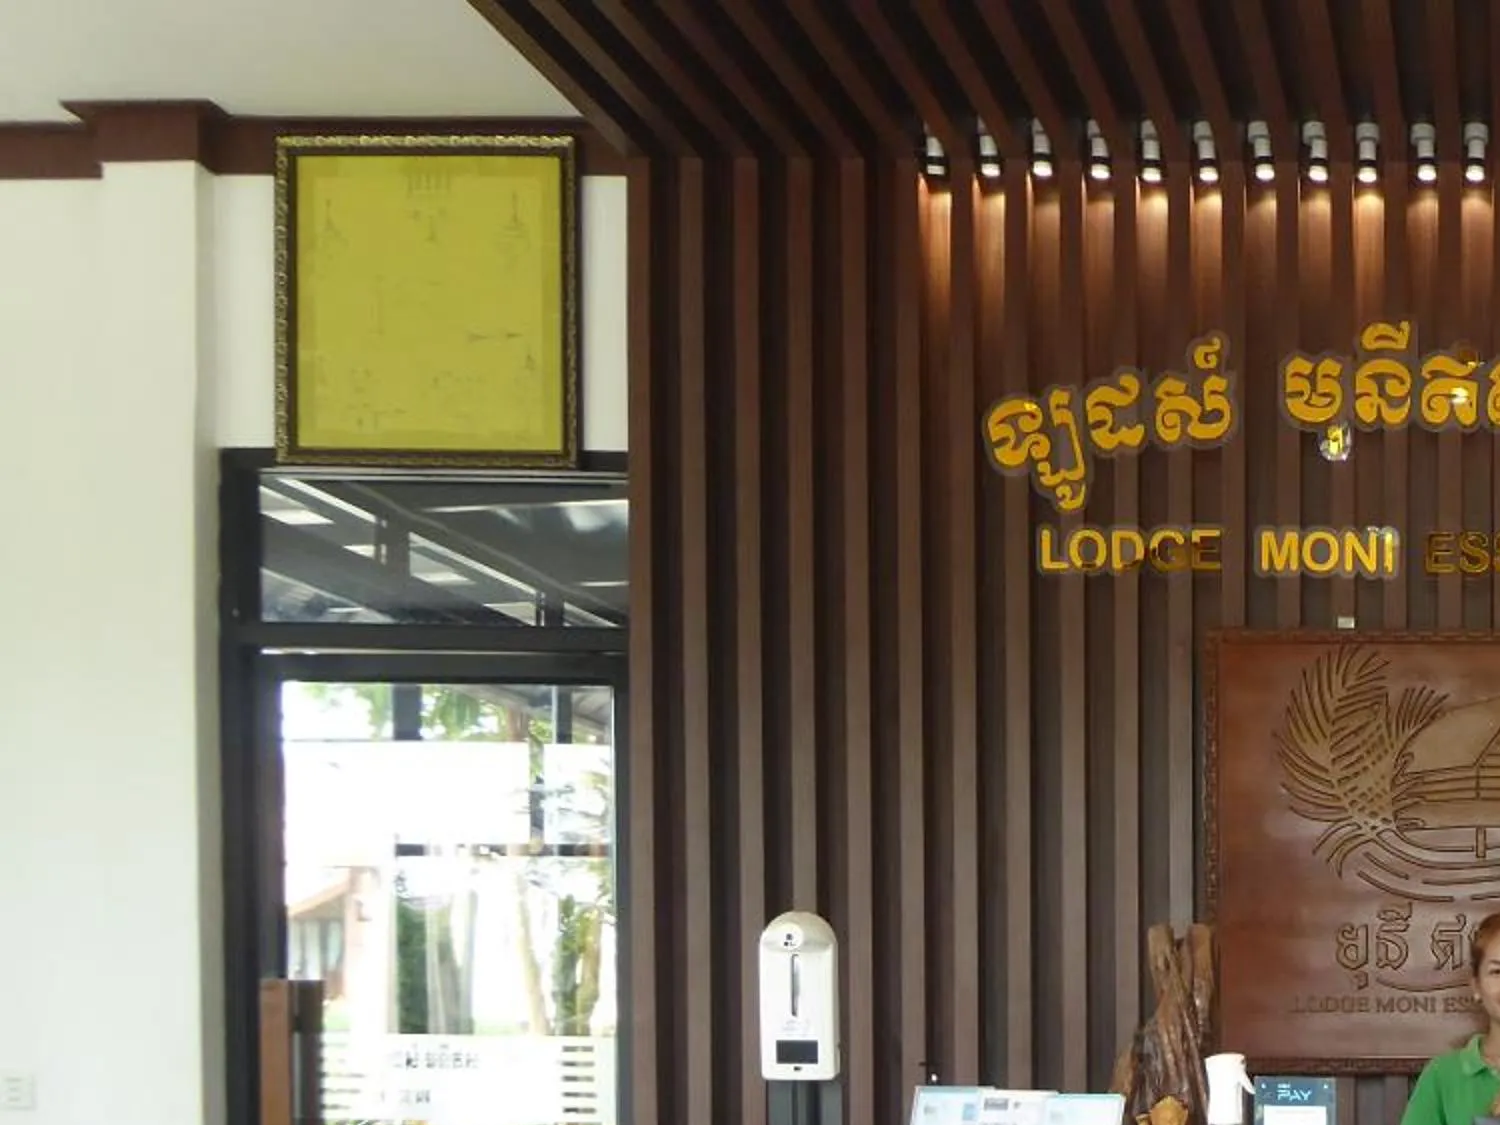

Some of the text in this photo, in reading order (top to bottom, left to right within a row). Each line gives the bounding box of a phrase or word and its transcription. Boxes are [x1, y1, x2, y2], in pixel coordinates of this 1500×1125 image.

[1041, 529, 1222, 571] LODGE
[1261, 530, 1393, 573] MONI
[1376, 996, 1436, 1014] MONI
[1277, 1089, 1312, 1101] PAY
